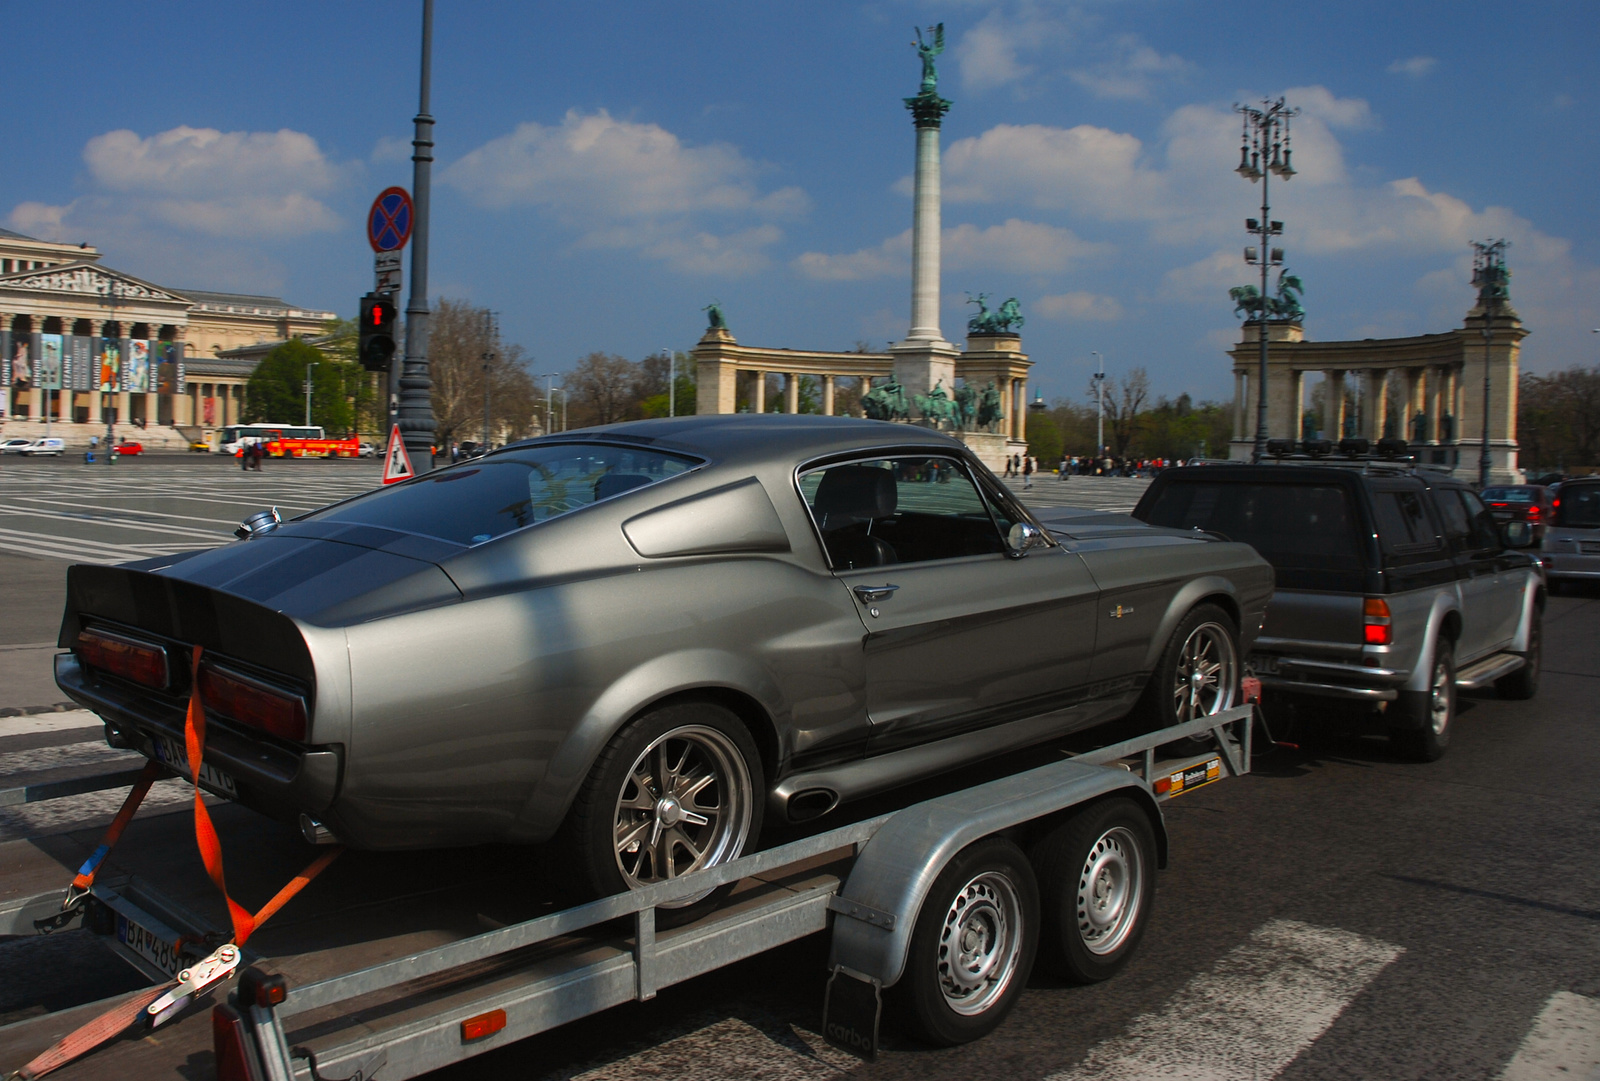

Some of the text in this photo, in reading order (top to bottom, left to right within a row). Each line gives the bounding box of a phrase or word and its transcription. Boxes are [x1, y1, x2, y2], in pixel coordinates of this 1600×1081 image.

[2, 358, 11, 386] MONET
[33, 359, 41, 387] RENOIR
[150, 362, 158, 391] BRAQUE
[177, 363, 185, 393] PICASSO
[827, 1022, 872, 1052] carbo
